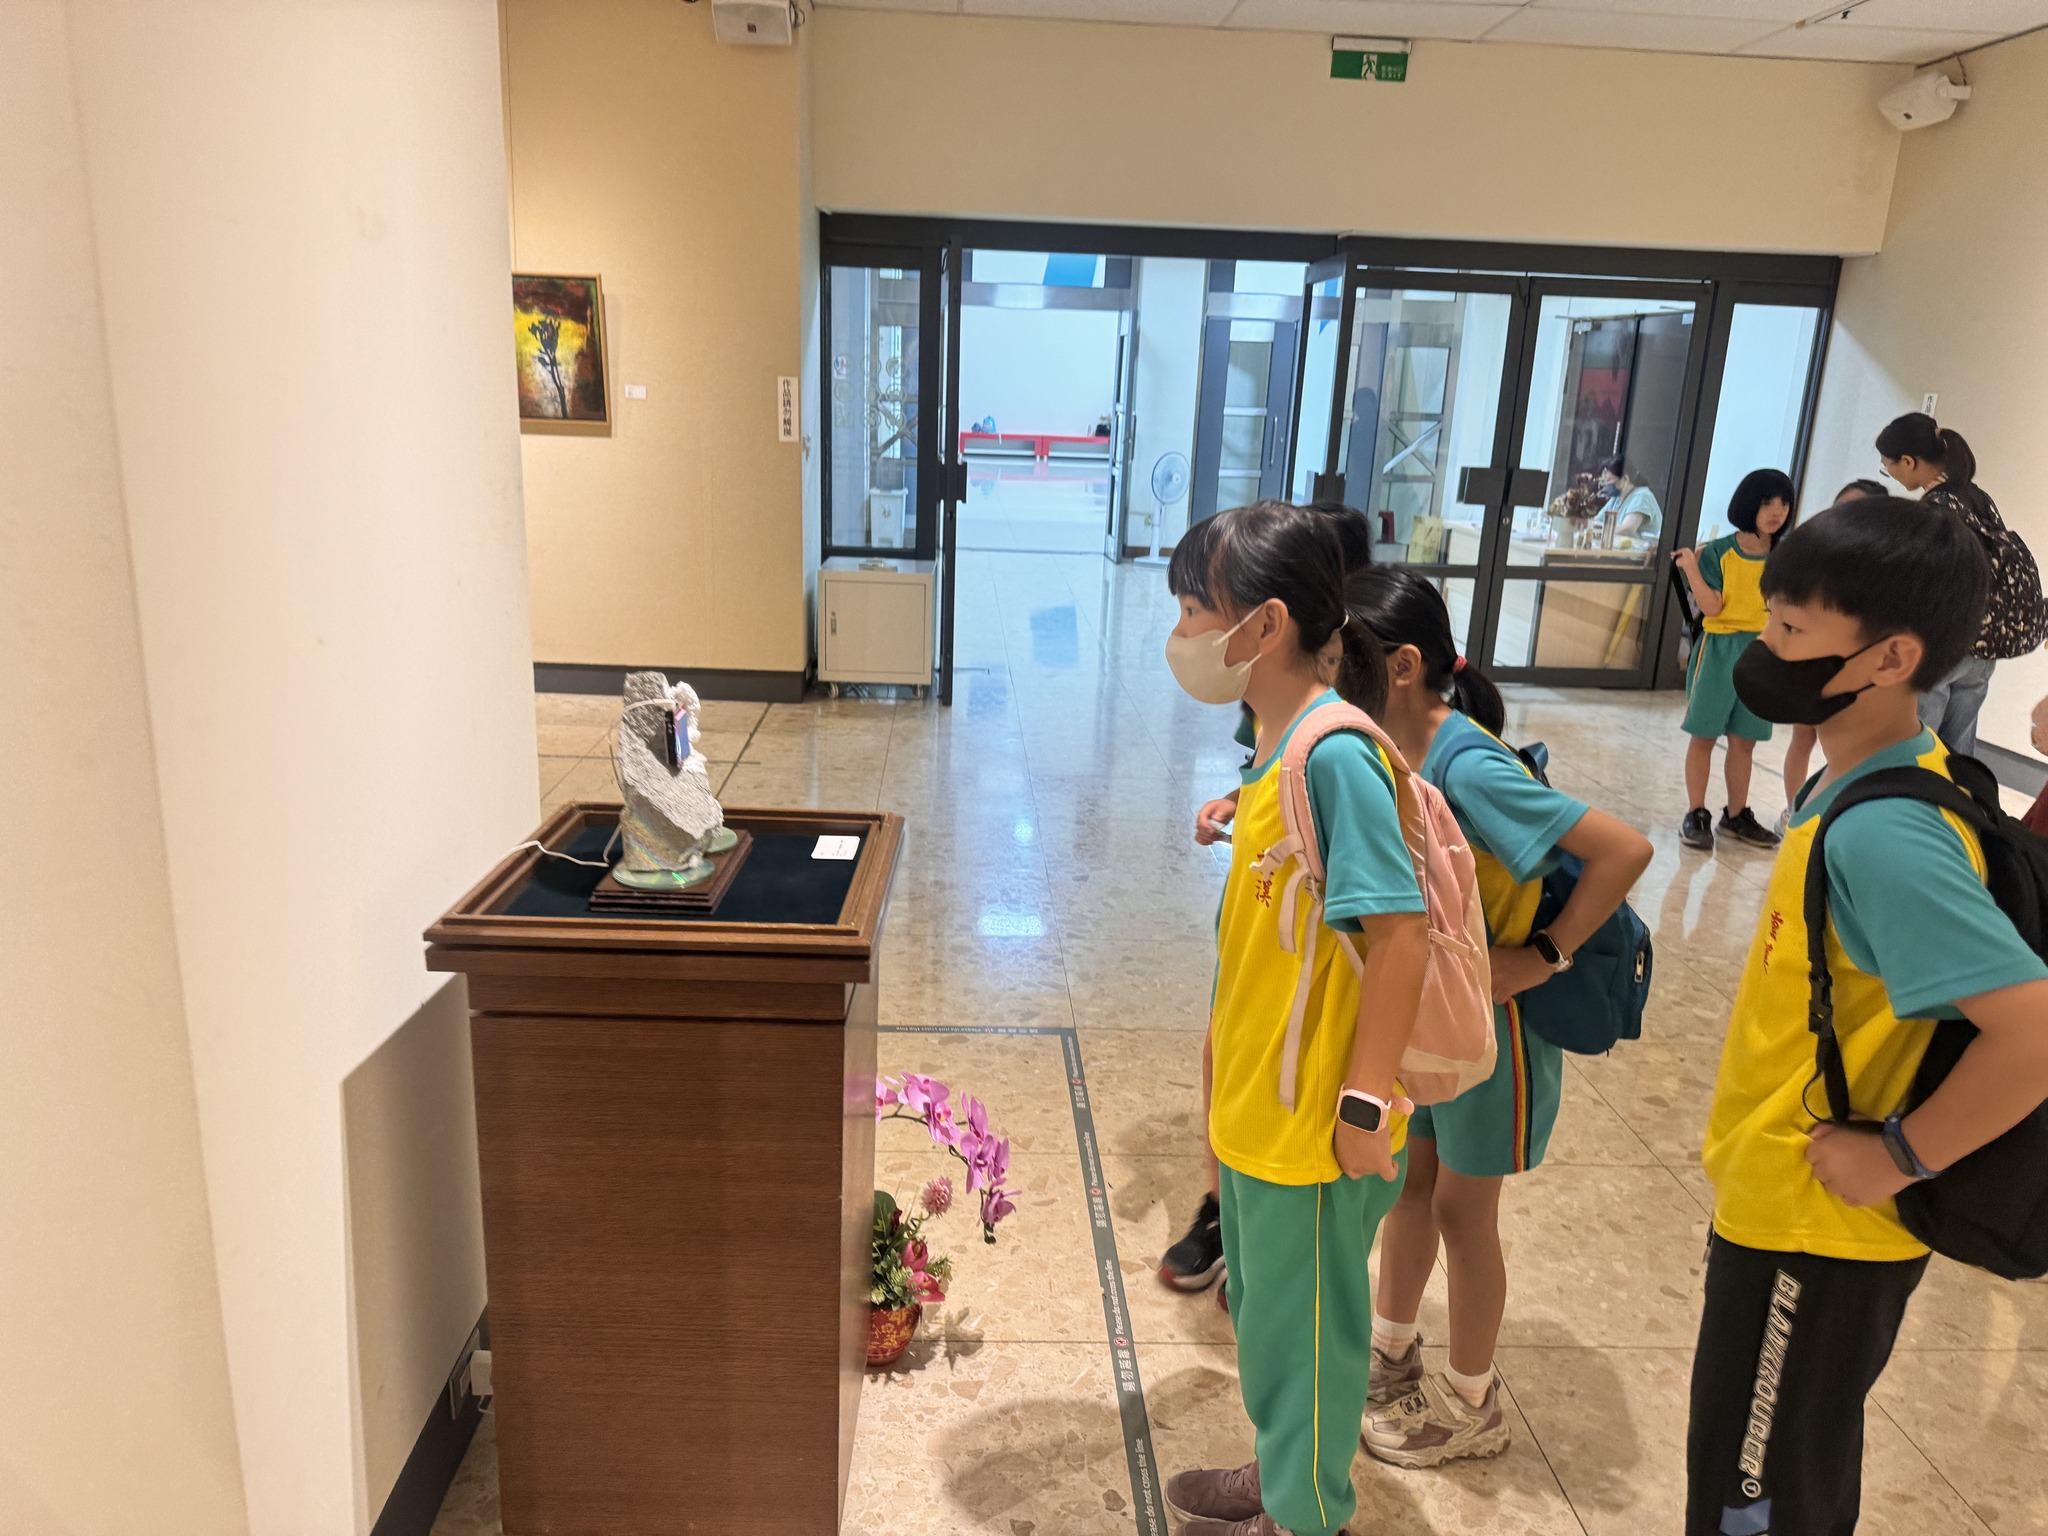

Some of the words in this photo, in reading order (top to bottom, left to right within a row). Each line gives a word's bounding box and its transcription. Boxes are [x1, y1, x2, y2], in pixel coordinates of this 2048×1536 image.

[1135, 1438, 1144, 1452] line
[1137, 1453, 1147, 1467] the
[1141, 1468, 1150, 1488] cross
[1144, 1489, 1152, 1504] not
[1145, 1505, 1155, 1517] do
